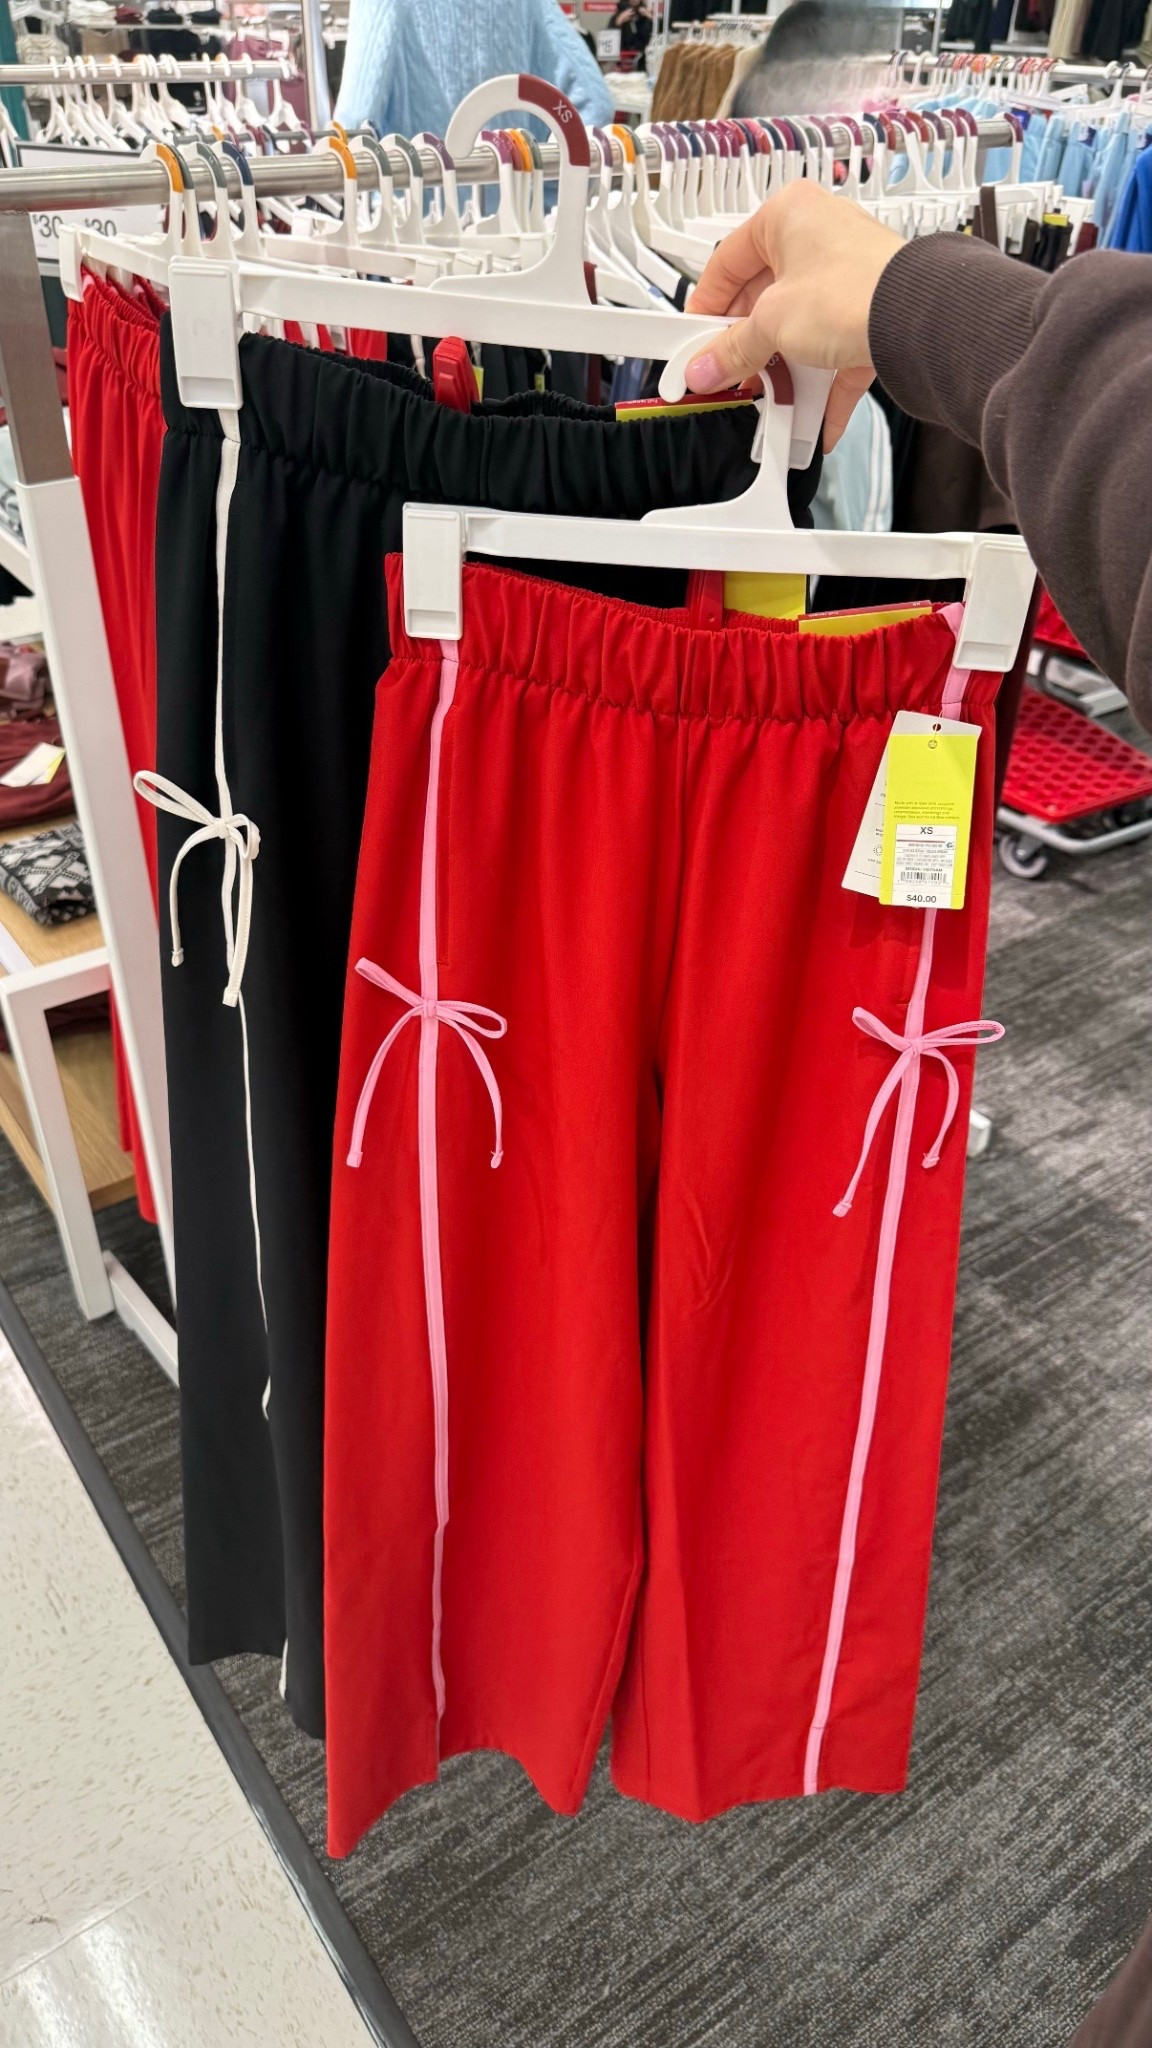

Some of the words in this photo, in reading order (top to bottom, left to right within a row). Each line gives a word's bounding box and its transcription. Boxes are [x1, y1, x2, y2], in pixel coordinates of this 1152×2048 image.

[552, 99, 573, 123] XS
[920, 826, 933, 835] XS
[906, 894, 937, 903] $40.00
